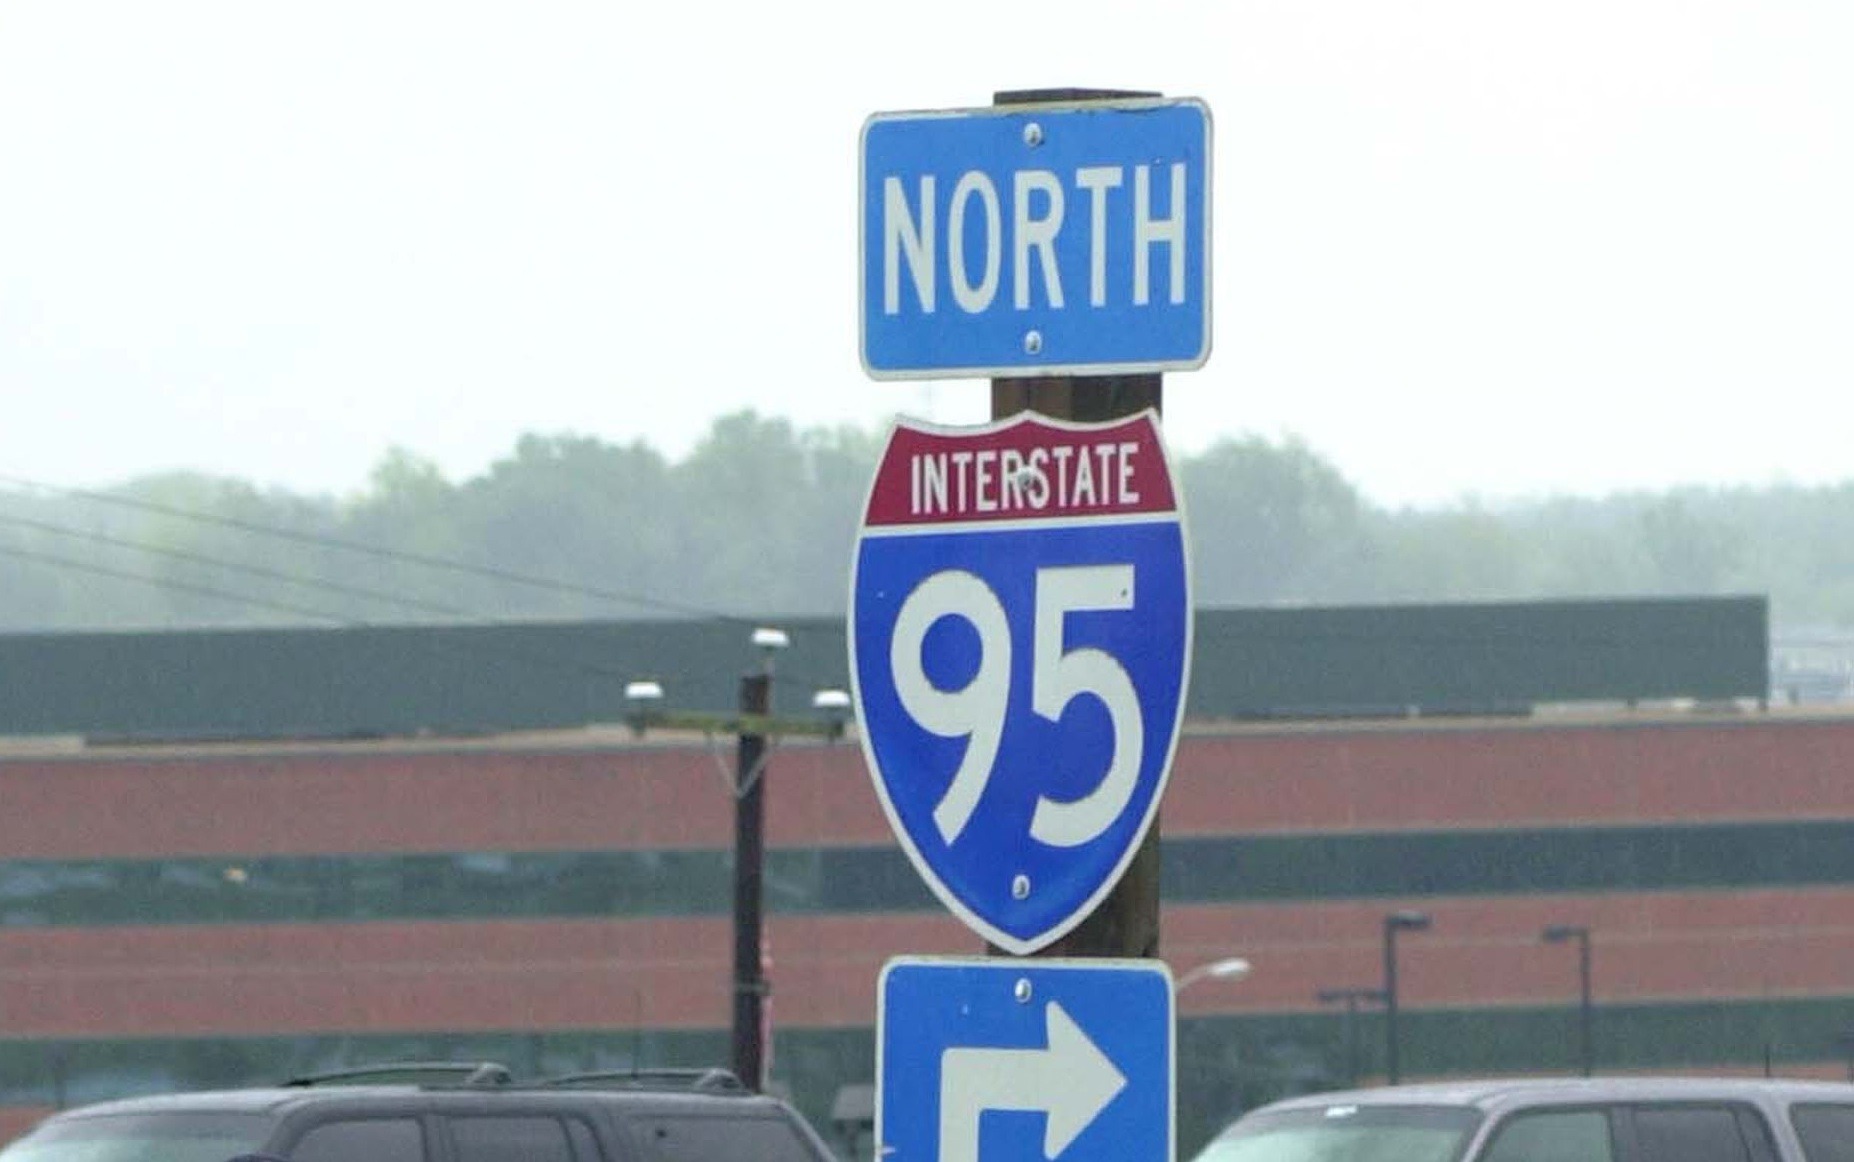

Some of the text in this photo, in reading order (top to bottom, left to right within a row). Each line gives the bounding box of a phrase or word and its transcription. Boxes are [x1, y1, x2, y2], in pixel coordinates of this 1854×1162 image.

[884, 163, 1187, 314] NORTH
[911, 443, 1139, 514] INTERSTATE
[890, 564, 1143, 847] 95
